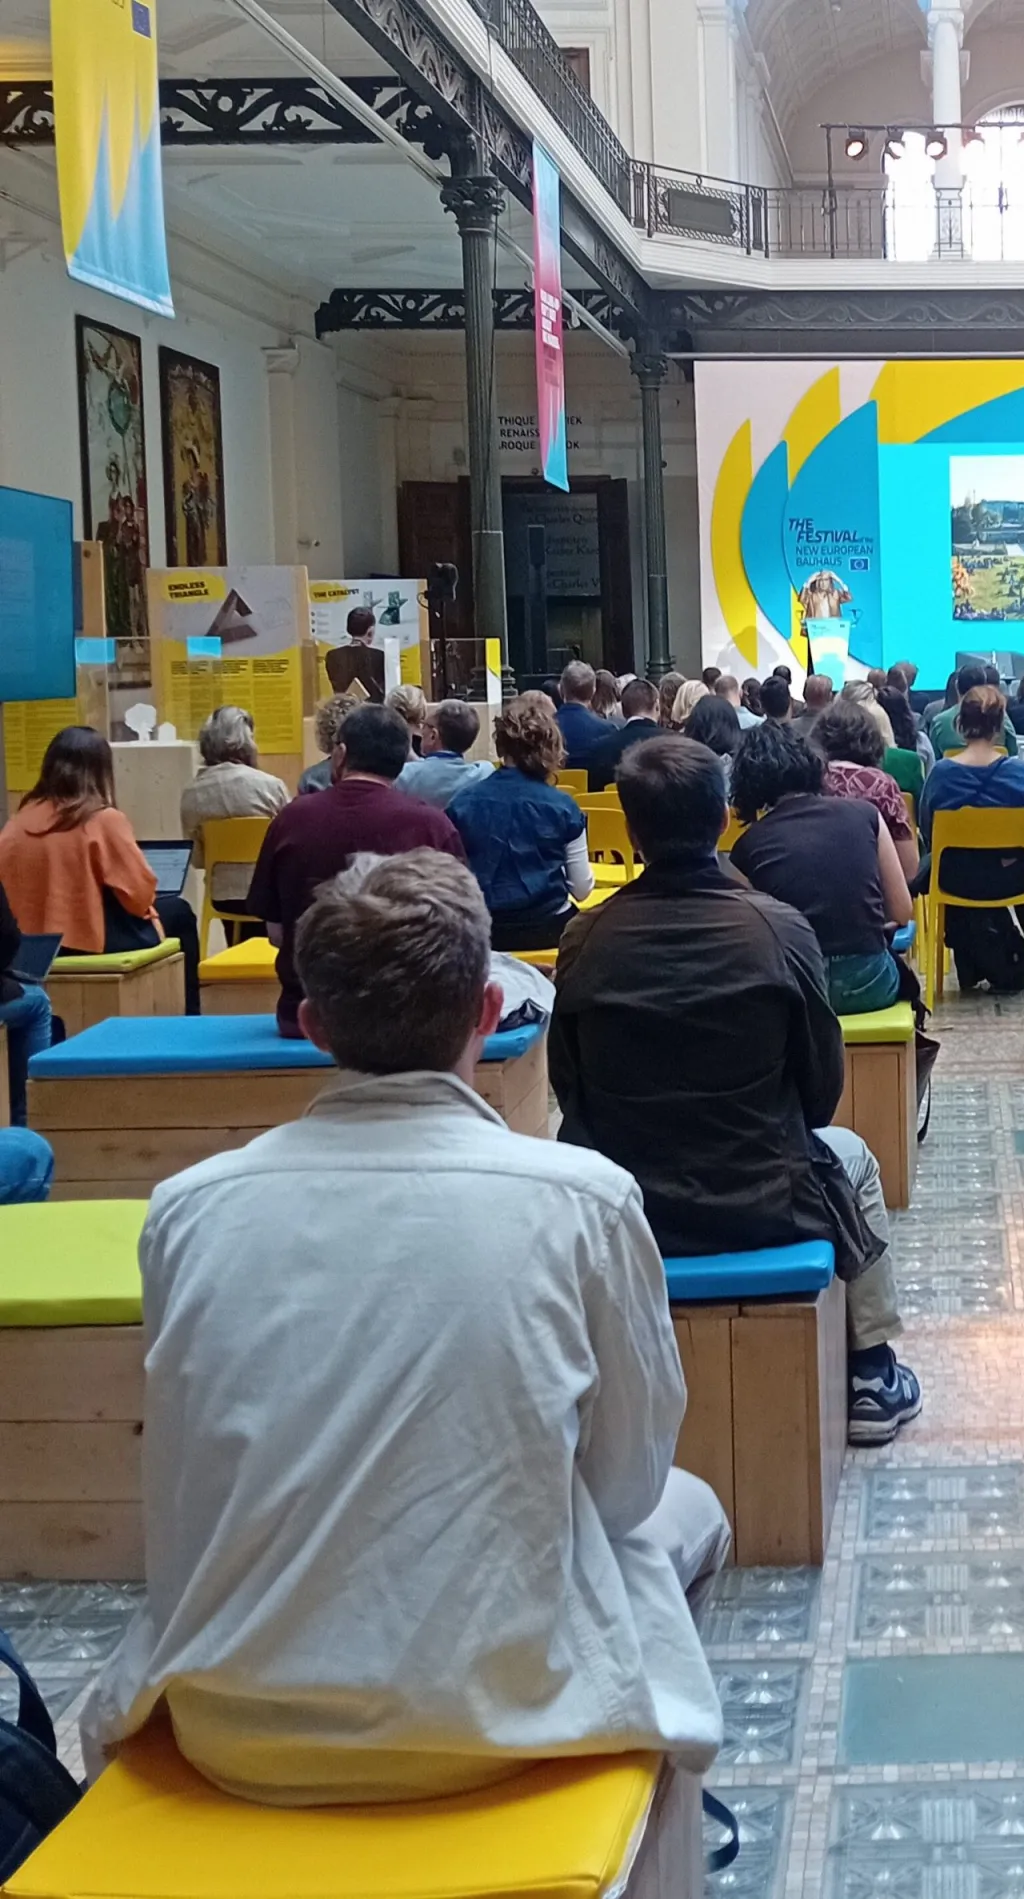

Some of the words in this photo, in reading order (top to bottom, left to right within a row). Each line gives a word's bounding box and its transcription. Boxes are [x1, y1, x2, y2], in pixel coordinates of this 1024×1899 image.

[498, 416, 536, 426] THIQUE
[566, 416, 582, 425] IEK
[500, 428, 540, 438] RENAISS
[499, 441, 536, 451] ROQUE
[566, 441, 580, 450] OK
[788, 518, 814, 531] THE
[797, 530, 858, 543] FESTIVAL
[796, 545, 819, 555] NEW
[821, 545, 873, 555] EUROPEAN
[796, 557, 842, 567] BAUHAUS
[168, 581, 205, 591] ENDLESS
[169, 589, 209, 599] TRIANGLE
[328, 589, 359, 597] CATALYST
